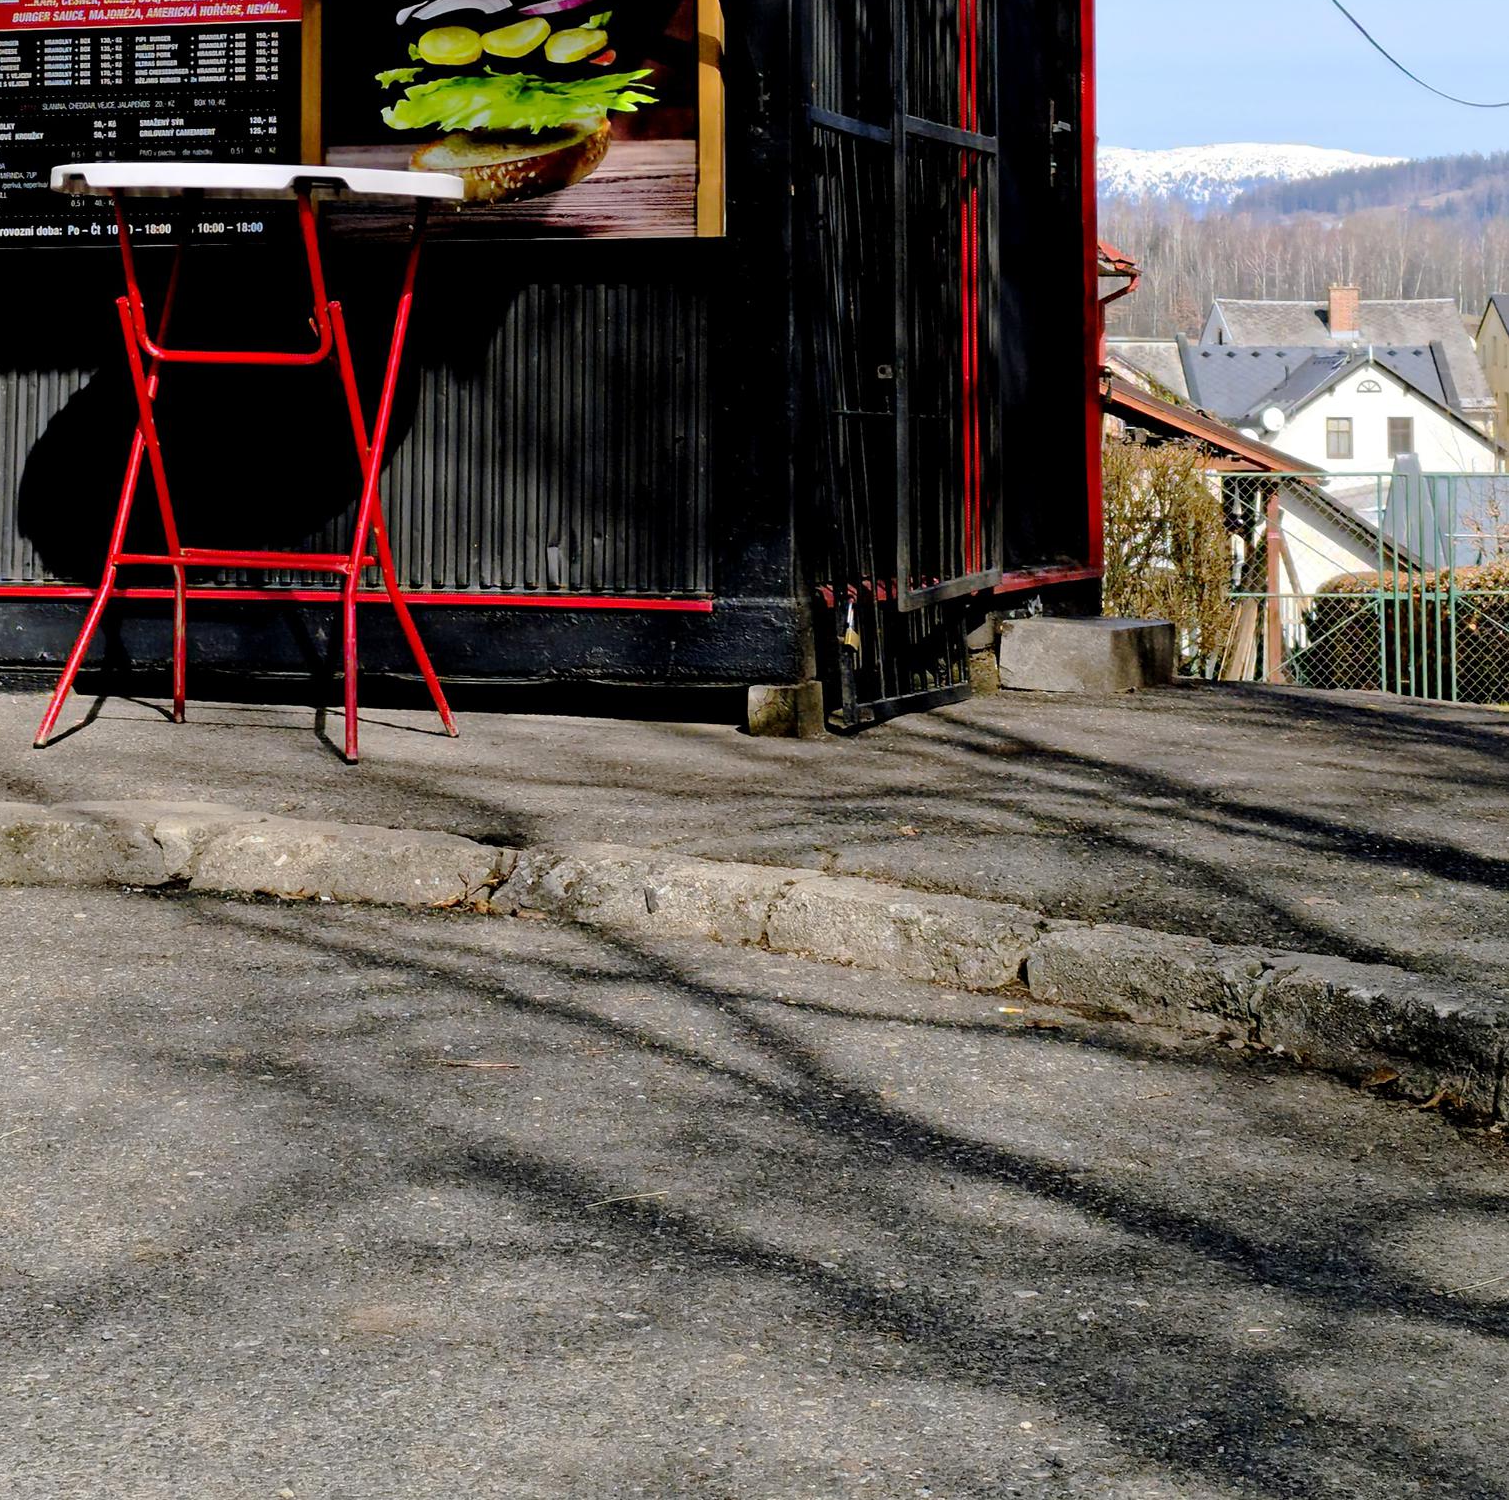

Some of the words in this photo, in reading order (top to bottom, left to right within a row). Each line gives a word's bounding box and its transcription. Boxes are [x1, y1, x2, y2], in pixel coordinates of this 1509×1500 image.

[12, 12, 50, 22] BURGER
[53, 10, 86, 21] SAUCE,
[145, 3, 196, 18] AMERICKÁ
[36, 226, 62, 236] doba:
[68, 225, 80, 235] Po
[91, 223, 101, 235] Čt
[145, 224, 171, 234] 18:00
[198, 223, 224, 233] 10:00
[236, 222, 263, 232] 18:00
